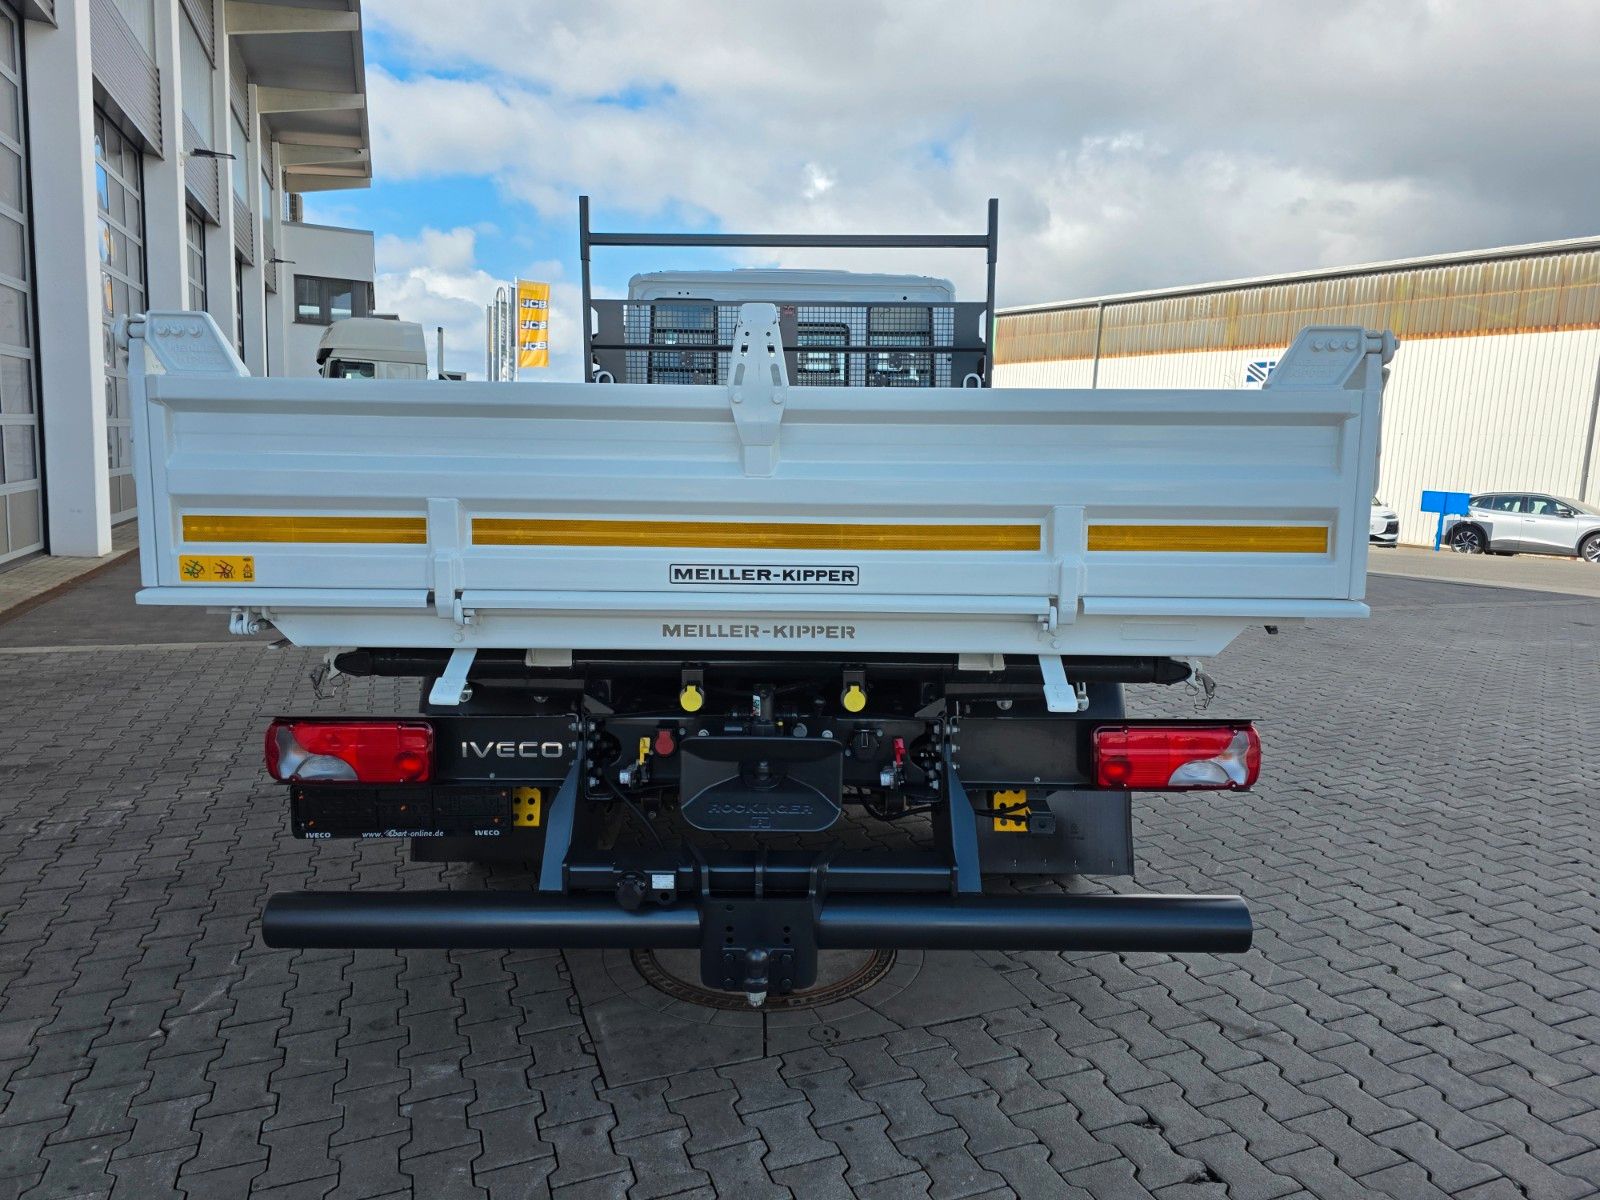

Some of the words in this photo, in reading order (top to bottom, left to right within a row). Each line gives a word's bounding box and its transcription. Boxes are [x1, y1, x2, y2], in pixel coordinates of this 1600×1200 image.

[521, 299, 547, 309] JCB
[521, 320, 547, 330] JCB
[521, 341, 547, 350] JCB
[674, 568, 855, 583] MEILLER-KIPPER
[662, 624, 856, 639] MEILLER-KIPPER
[461, 741, 563, 758] IVECO
